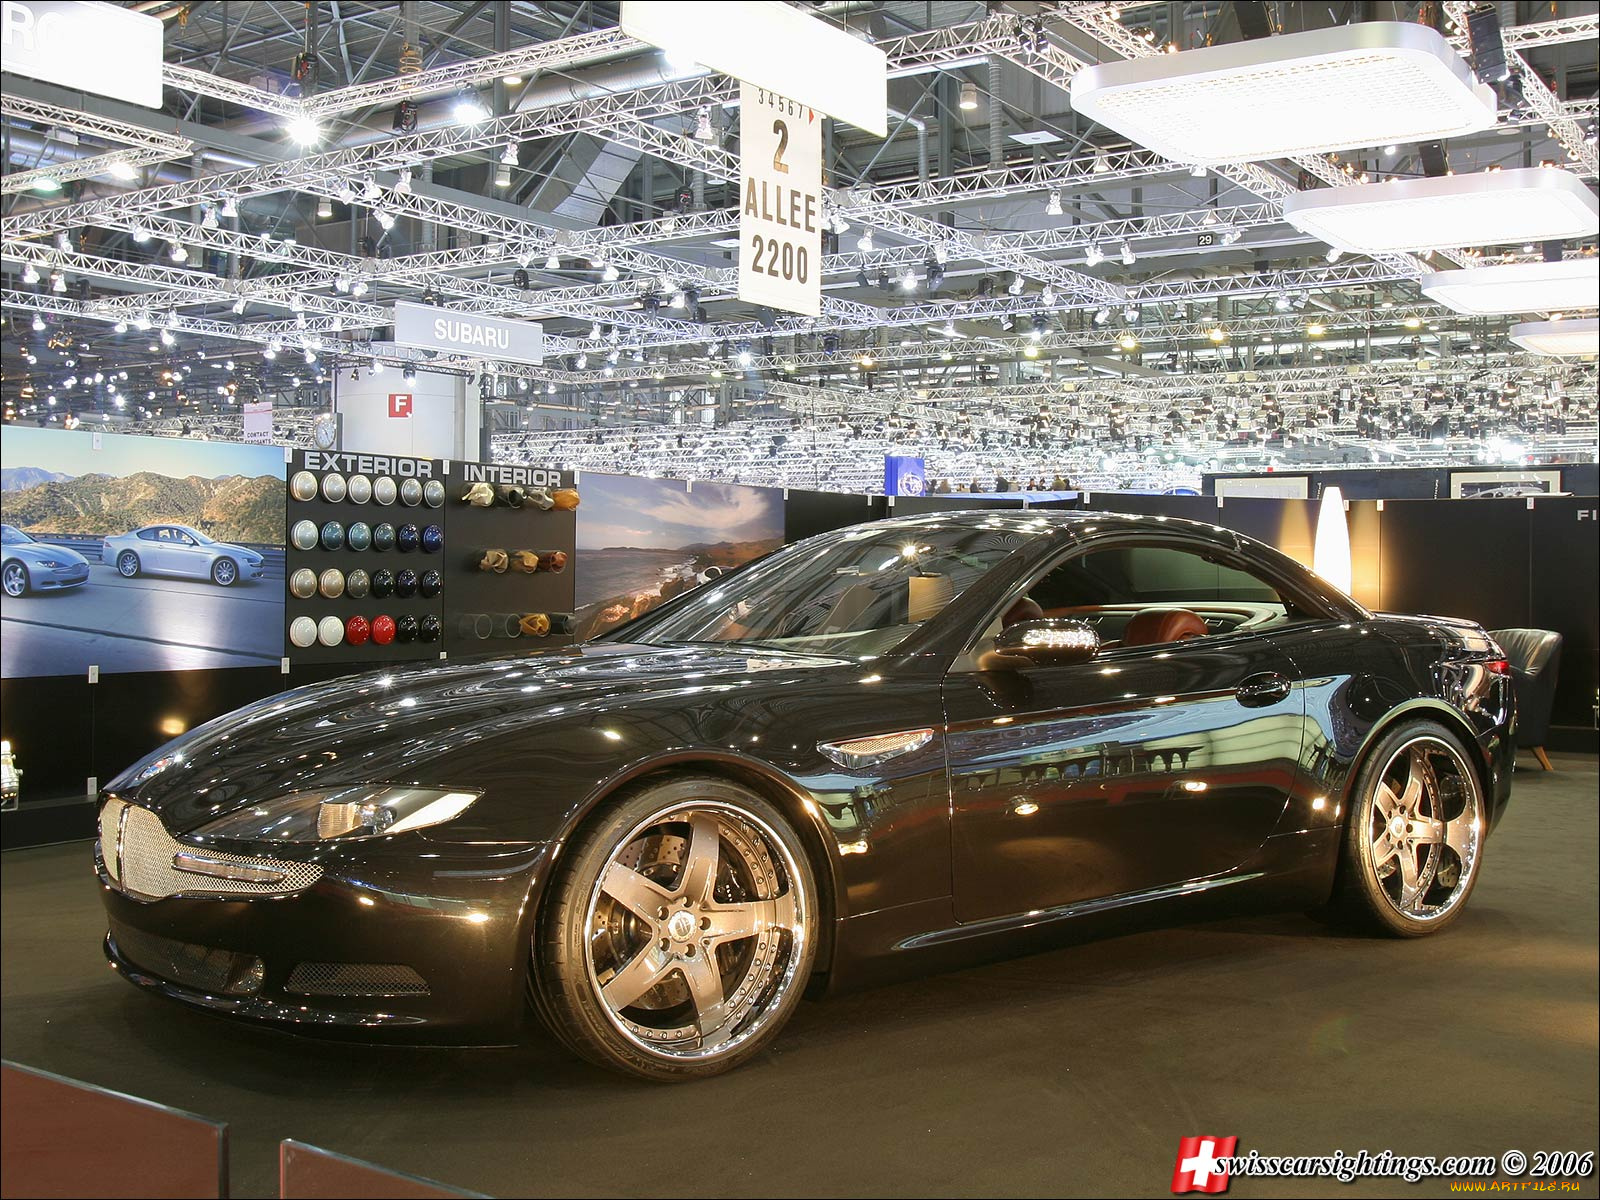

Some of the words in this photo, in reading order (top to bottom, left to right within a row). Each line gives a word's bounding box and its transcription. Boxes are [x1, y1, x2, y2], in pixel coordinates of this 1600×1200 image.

[773, 119, 789, 174] 2
[745, 176, 816, 234] ALLEE
[1199, 235, 1213, 246] 29
[752, 234, 808, 285] 2200
[434, 318, 509, 350] SUBARU
[395, 396, 407, 413] F
[247, 431, 269, 439] CONTACT
[304, 452, 433, 478] EXTERIOR
[464, 464, 561, 488] INTERIOR
